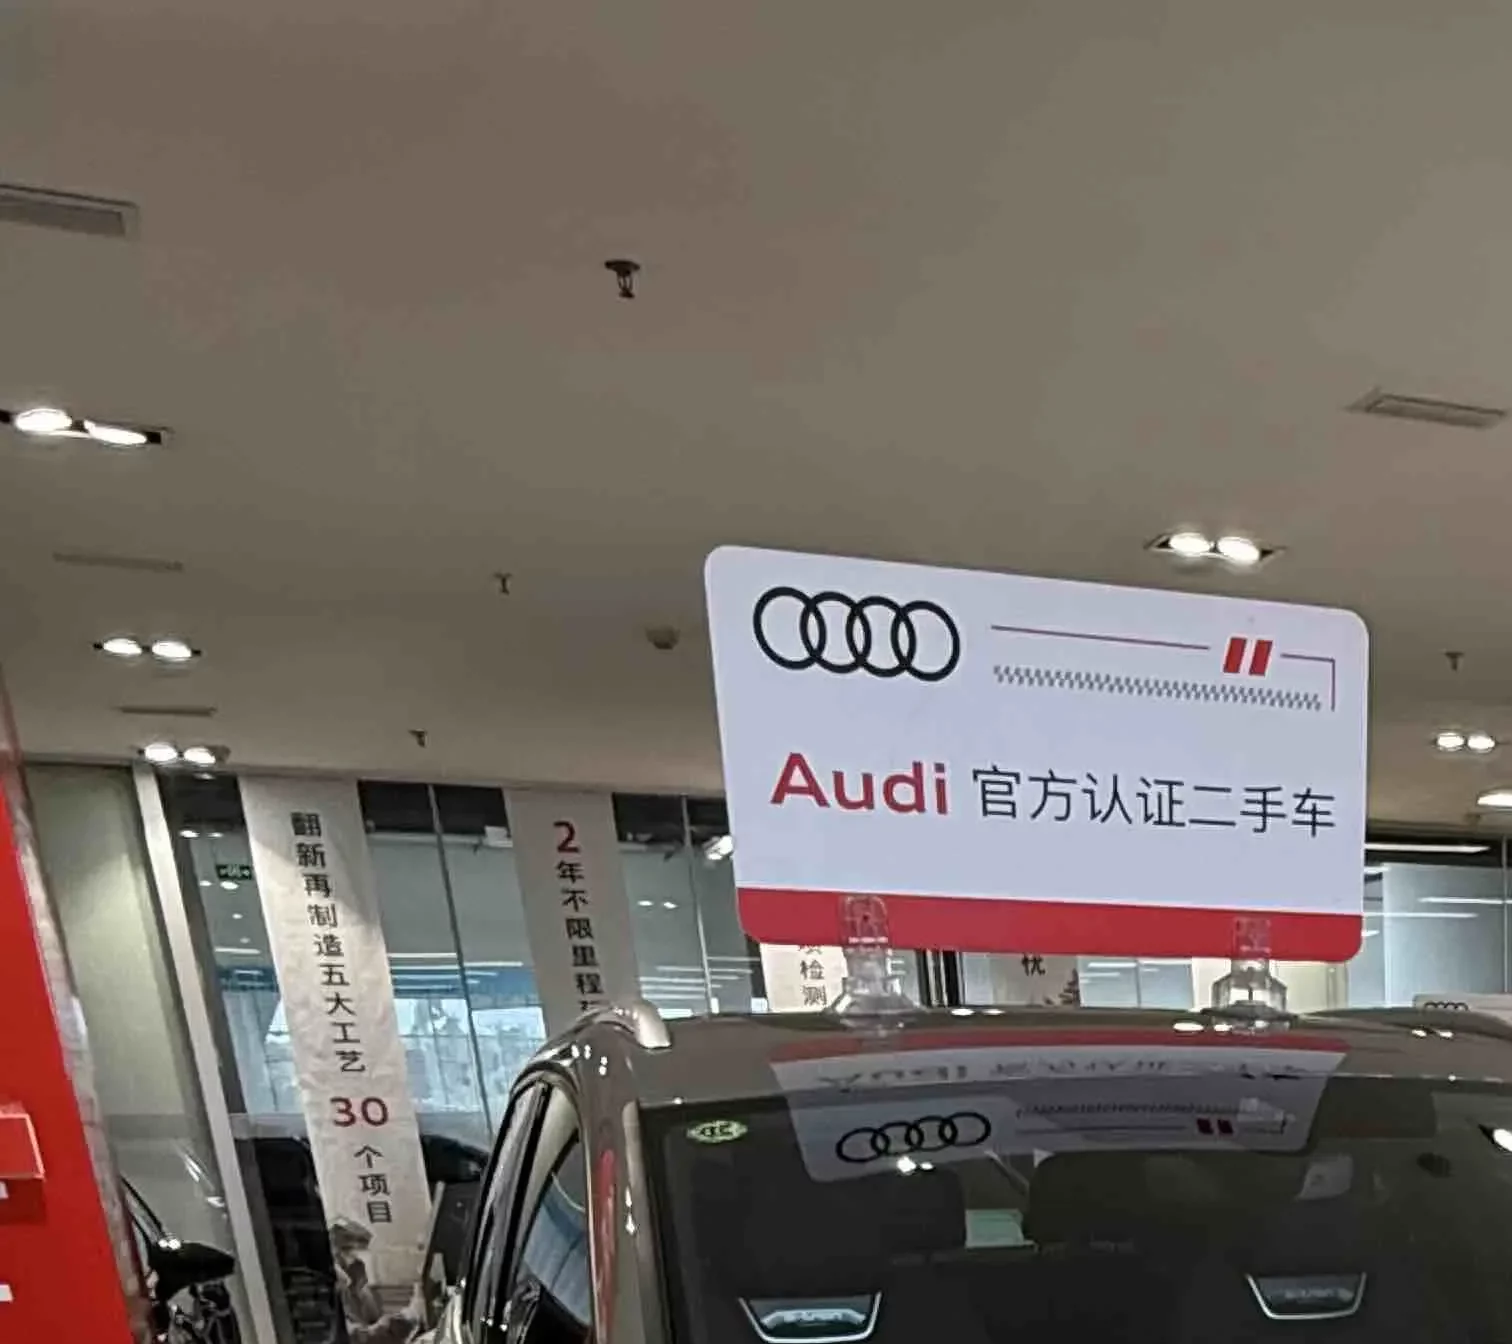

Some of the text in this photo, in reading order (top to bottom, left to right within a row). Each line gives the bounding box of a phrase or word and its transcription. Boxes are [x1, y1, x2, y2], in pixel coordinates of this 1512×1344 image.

[770, 752, 1336, 837] Audi 官方认证二手车
[291, 811, 393, 1224] 翻新再制造五大工艺 30 个项目
